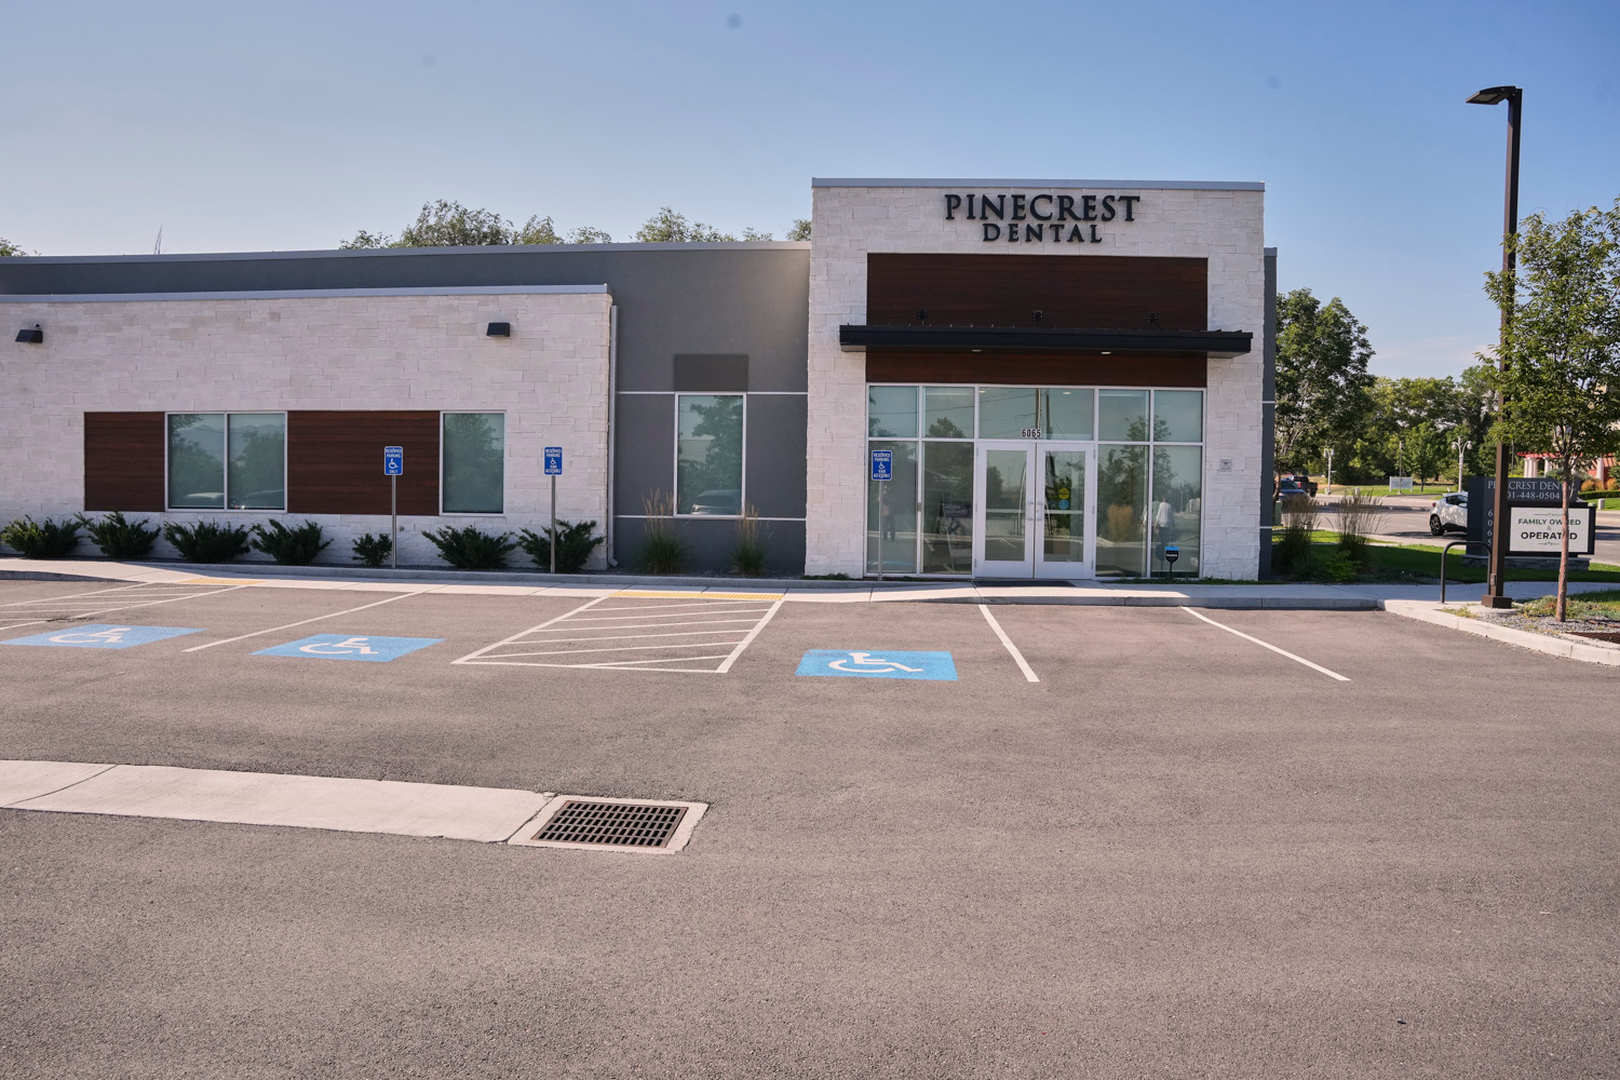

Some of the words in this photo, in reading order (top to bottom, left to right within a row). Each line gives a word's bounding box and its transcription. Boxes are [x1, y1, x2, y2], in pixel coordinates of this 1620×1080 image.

[944, 194, 1140, 222] PINECREST
[982, 223, 1102, 243] DENTAL
[1021, 428, 1041, 438] 6065
[1487, 480, 1537, 490] PICREST
[1507, 491, 1560, 499] 01-448-0504
[1520, 531, 1577, 540] OPERATD
